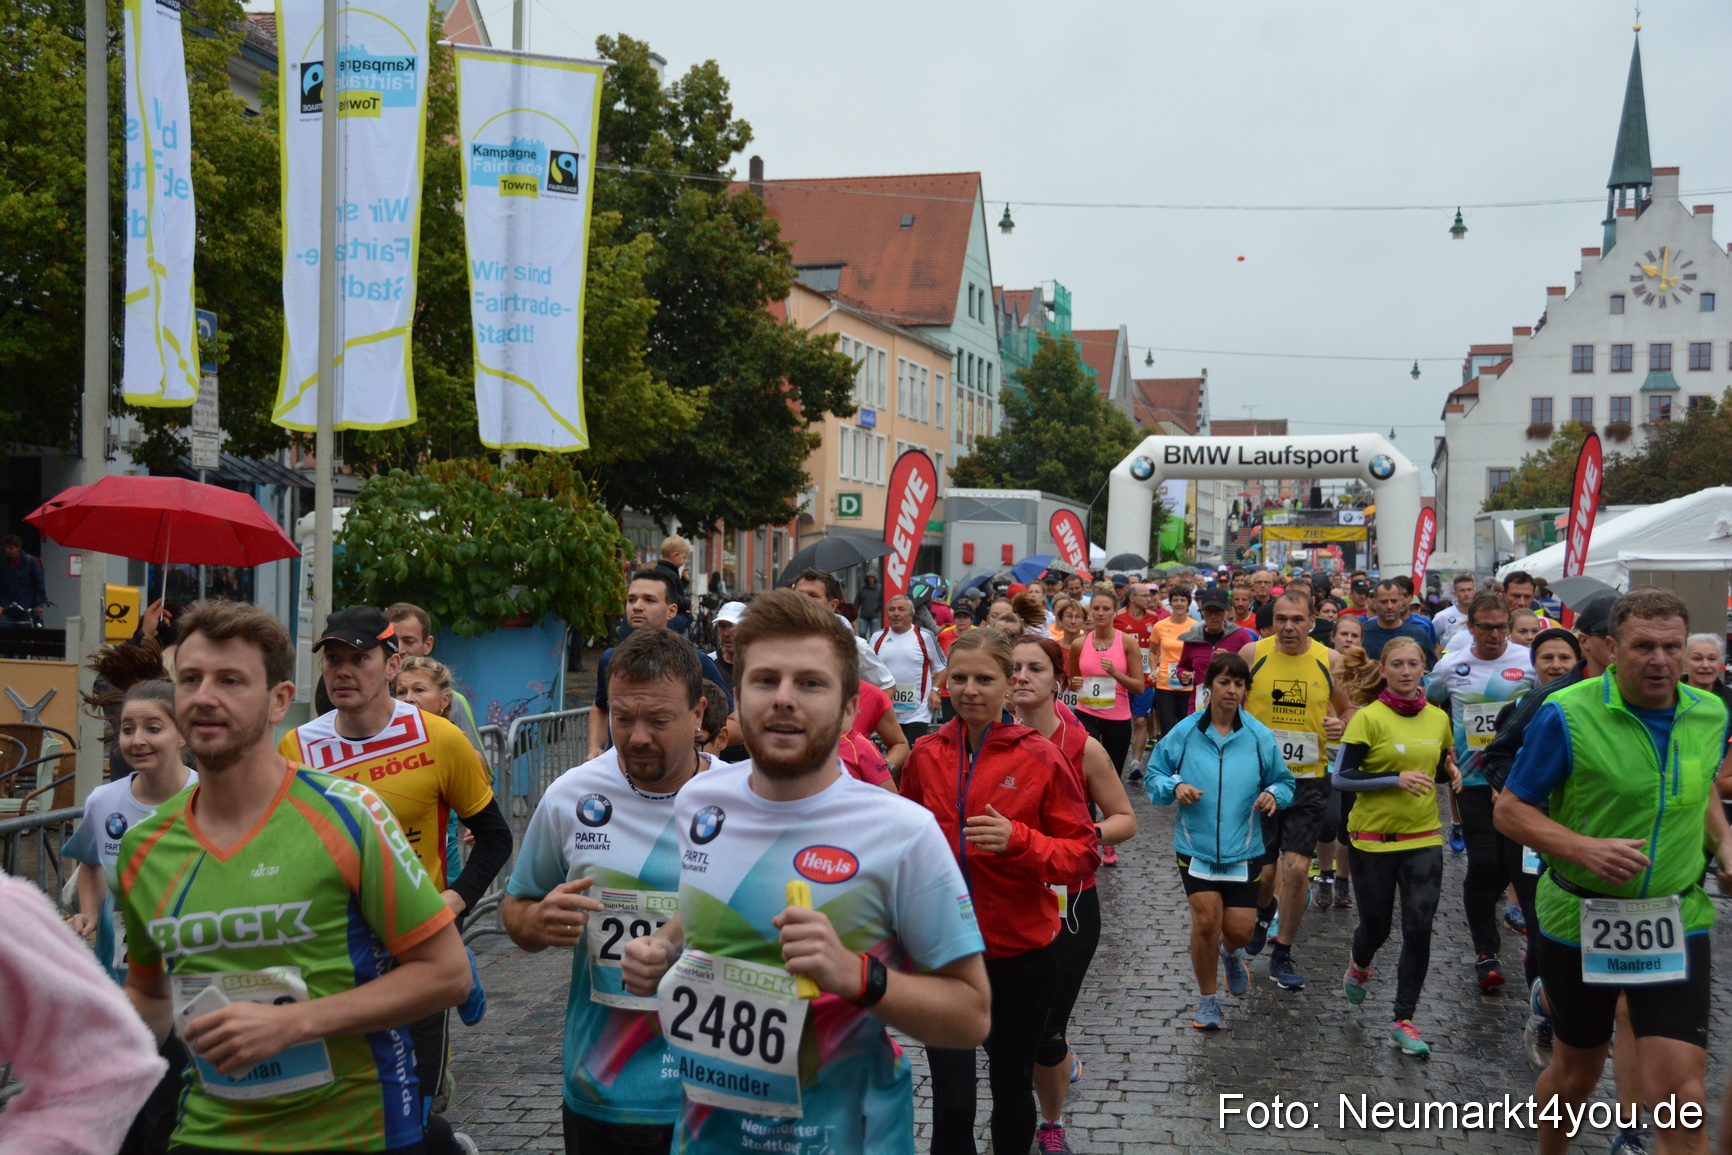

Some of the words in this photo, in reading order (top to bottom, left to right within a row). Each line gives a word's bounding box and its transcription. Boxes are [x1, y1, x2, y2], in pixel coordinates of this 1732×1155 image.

[472, 144, 537, 161] Kampagne
[473, 157, 543, 176] Fairtrade
[500, 180, 537, 193] Towns
[548, 183, 578, 194] FAIRTRADE
[471, 259, 508, 281] Wir
[513, 262, 552, 286] sind
[1164, 444, 1232, 465] BMW
[1238, 444, 1360, 469] Laufsport
[841, 496, 859, 513] D
[1566, 455, 1599, 578] REWE
[887, 467, 929, 590] REWE
[1303, 529, 1327, 539] ZIEL
[1414, 515, 1434, 577] REWE
[1092, 683, 1101, 697] 8
[1272, 706, 1306, 716] HIRSCH
[1282, 742, 1304, 761] 94
[369, 752, 435, 782] BÖGL
[105, 842, 121, 851] PART
[575, 832, 611, 844] PARTL
[575, 842, 611, 851] Neumarkt
[682, 849, 710, 865] PARTL
[802, 851, 851, 875] Hervis
[149, 899, 318, 959] BOCK
[1591, 917, 1675, 951] 2360
[1607, 957, 1662, 971] Manfred
[723, 963, 797, 997] BOCK
[670, 984, 788, 1065] 2486
[680, 1055, 771, 1097] Alexander
